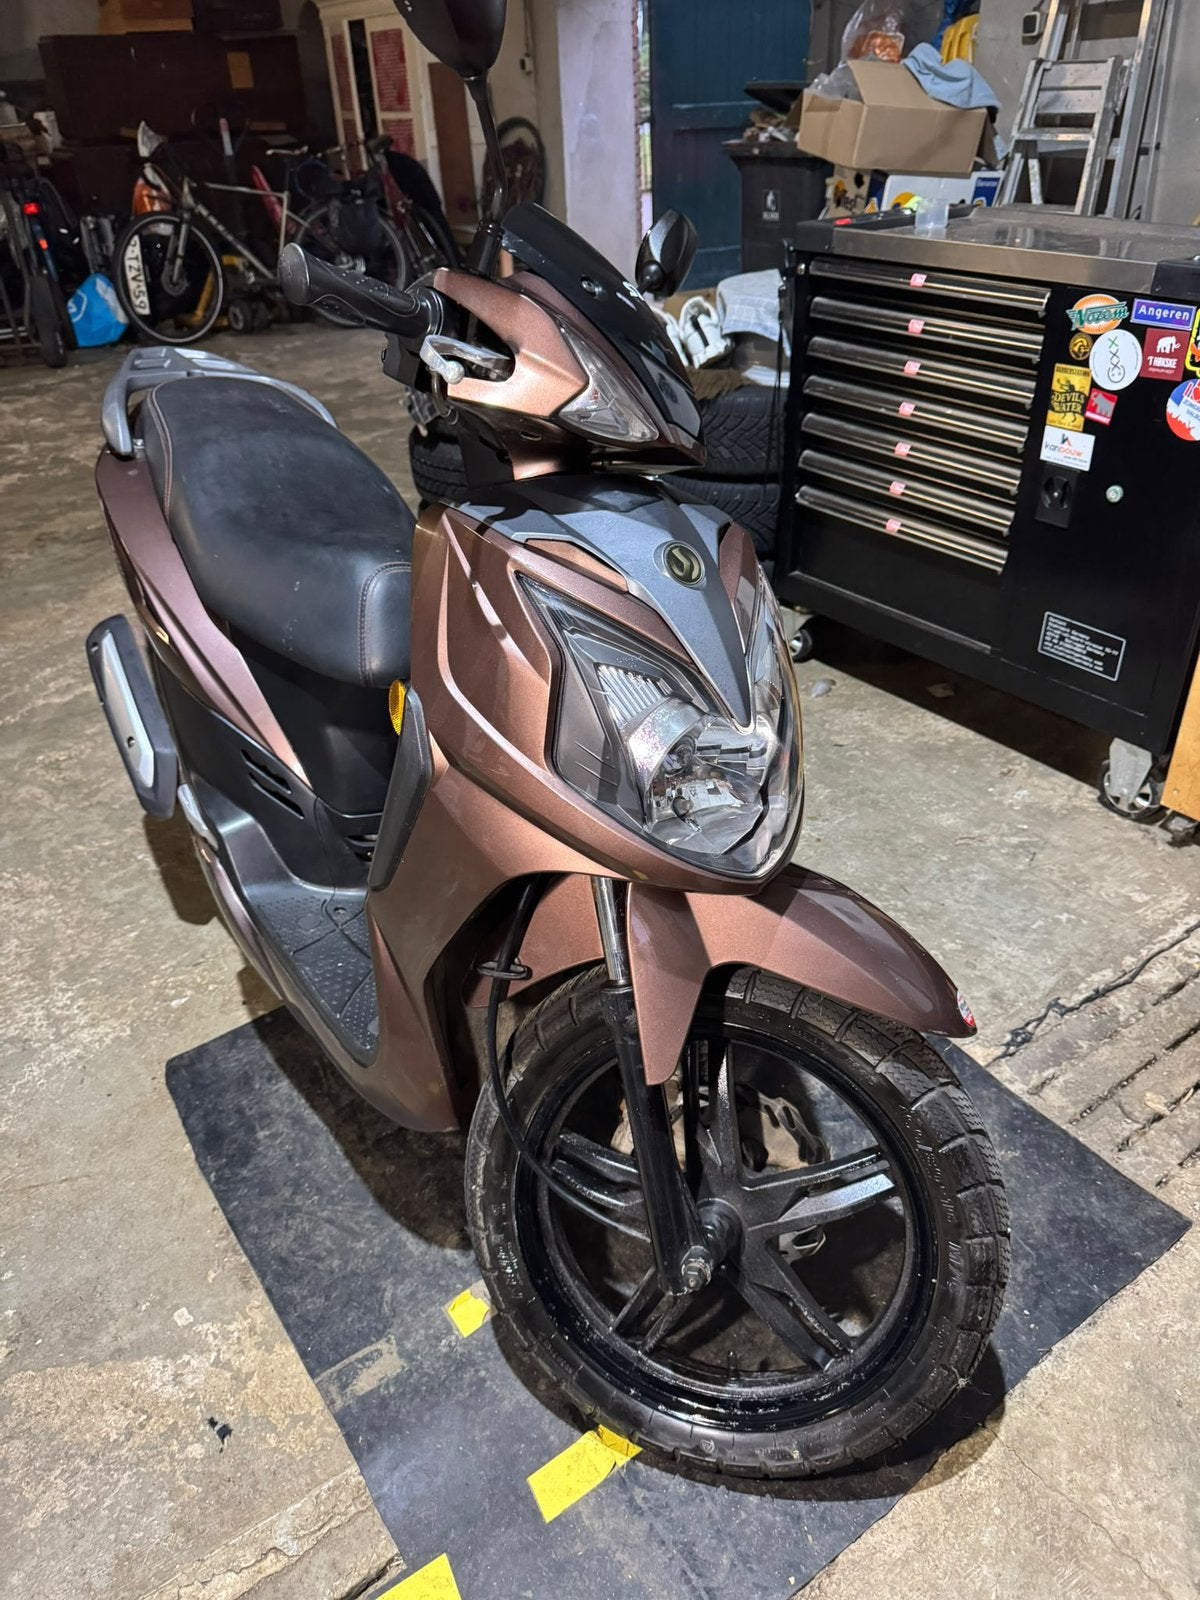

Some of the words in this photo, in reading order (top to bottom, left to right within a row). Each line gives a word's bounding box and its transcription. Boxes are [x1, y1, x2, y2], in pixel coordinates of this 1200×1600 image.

[1138, 304, 1190, 321] Angeren
[1054, 391, 1085, 404] DEVILS
[1053, 401, 1082, 413] WATER
